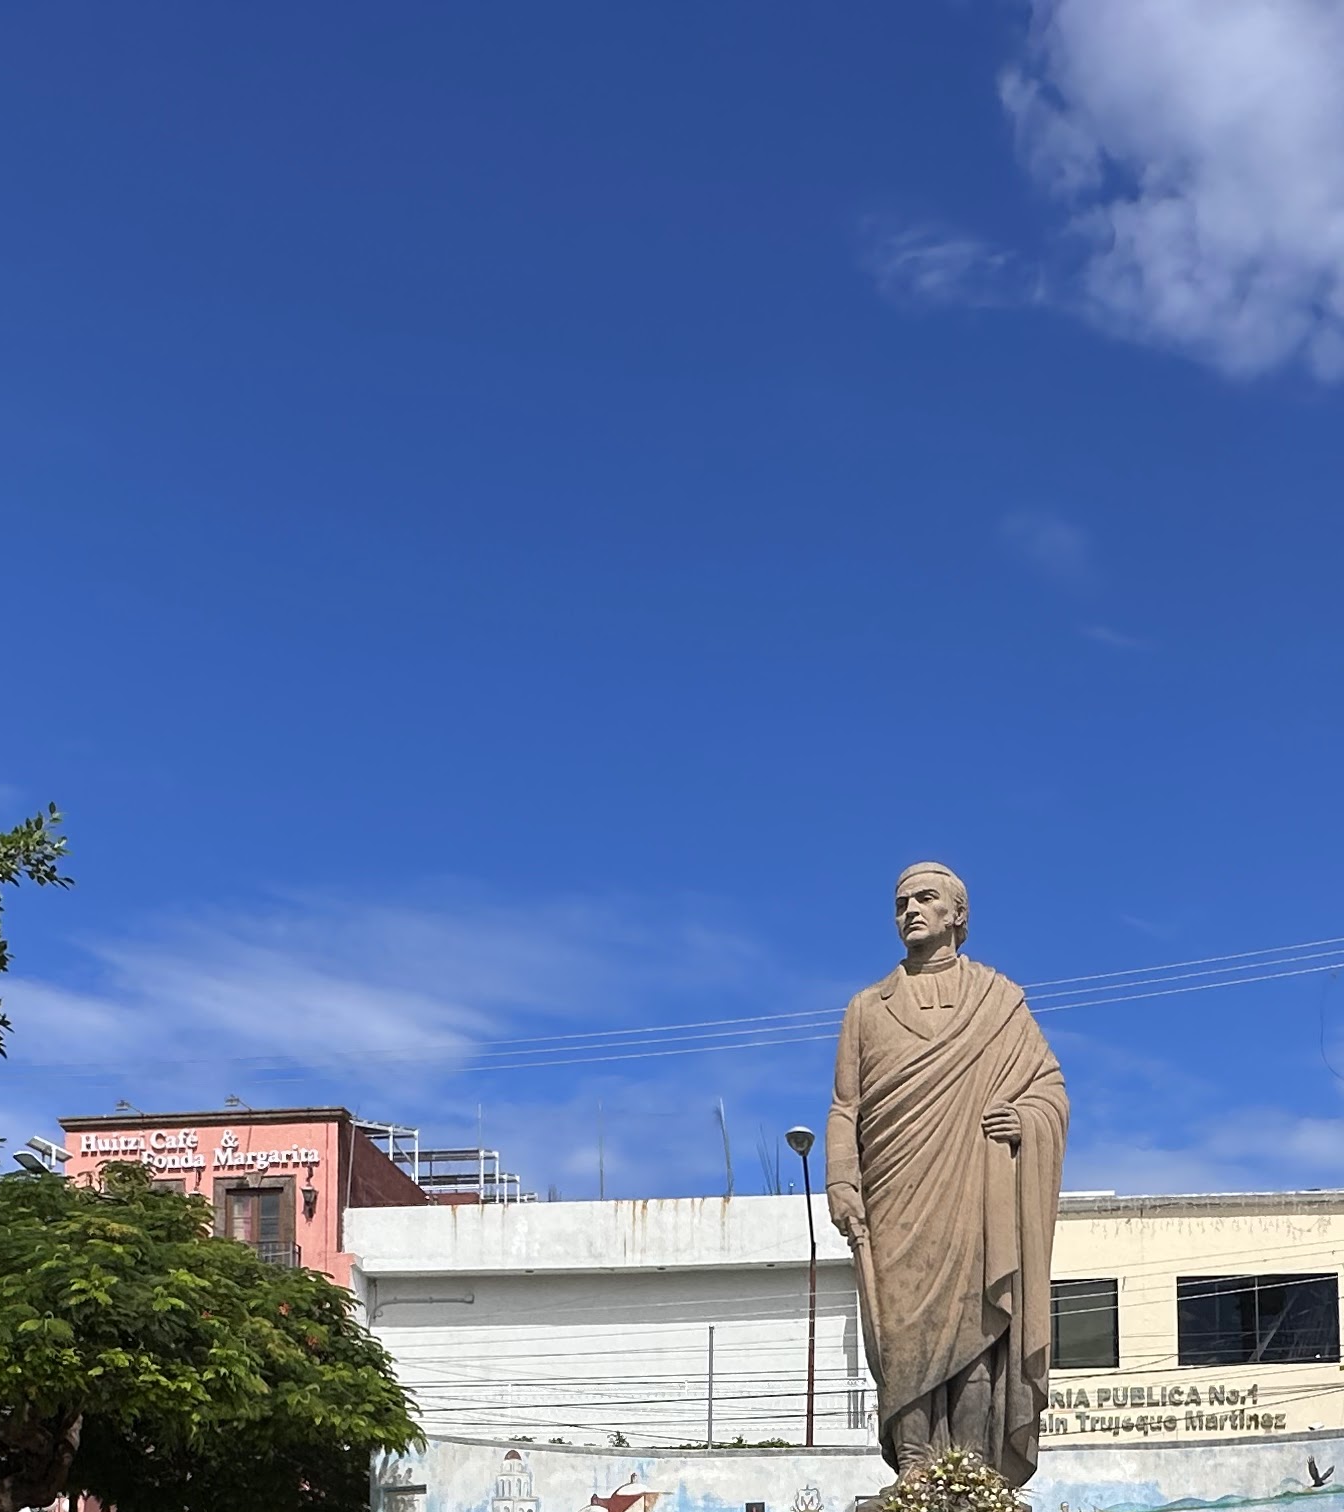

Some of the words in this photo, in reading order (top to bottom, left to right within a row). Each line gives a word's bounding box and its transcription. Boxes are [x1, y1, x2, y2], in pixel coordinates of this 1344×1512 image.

[80, 1134, 145, 1153] Huitzi
[150, 1128, 199, 1149] Café
[220, 1130, 239, 1148] &
[141, 1150, 206, 1170] Fonda
[212, 1145, 320, 1169] Margarita
